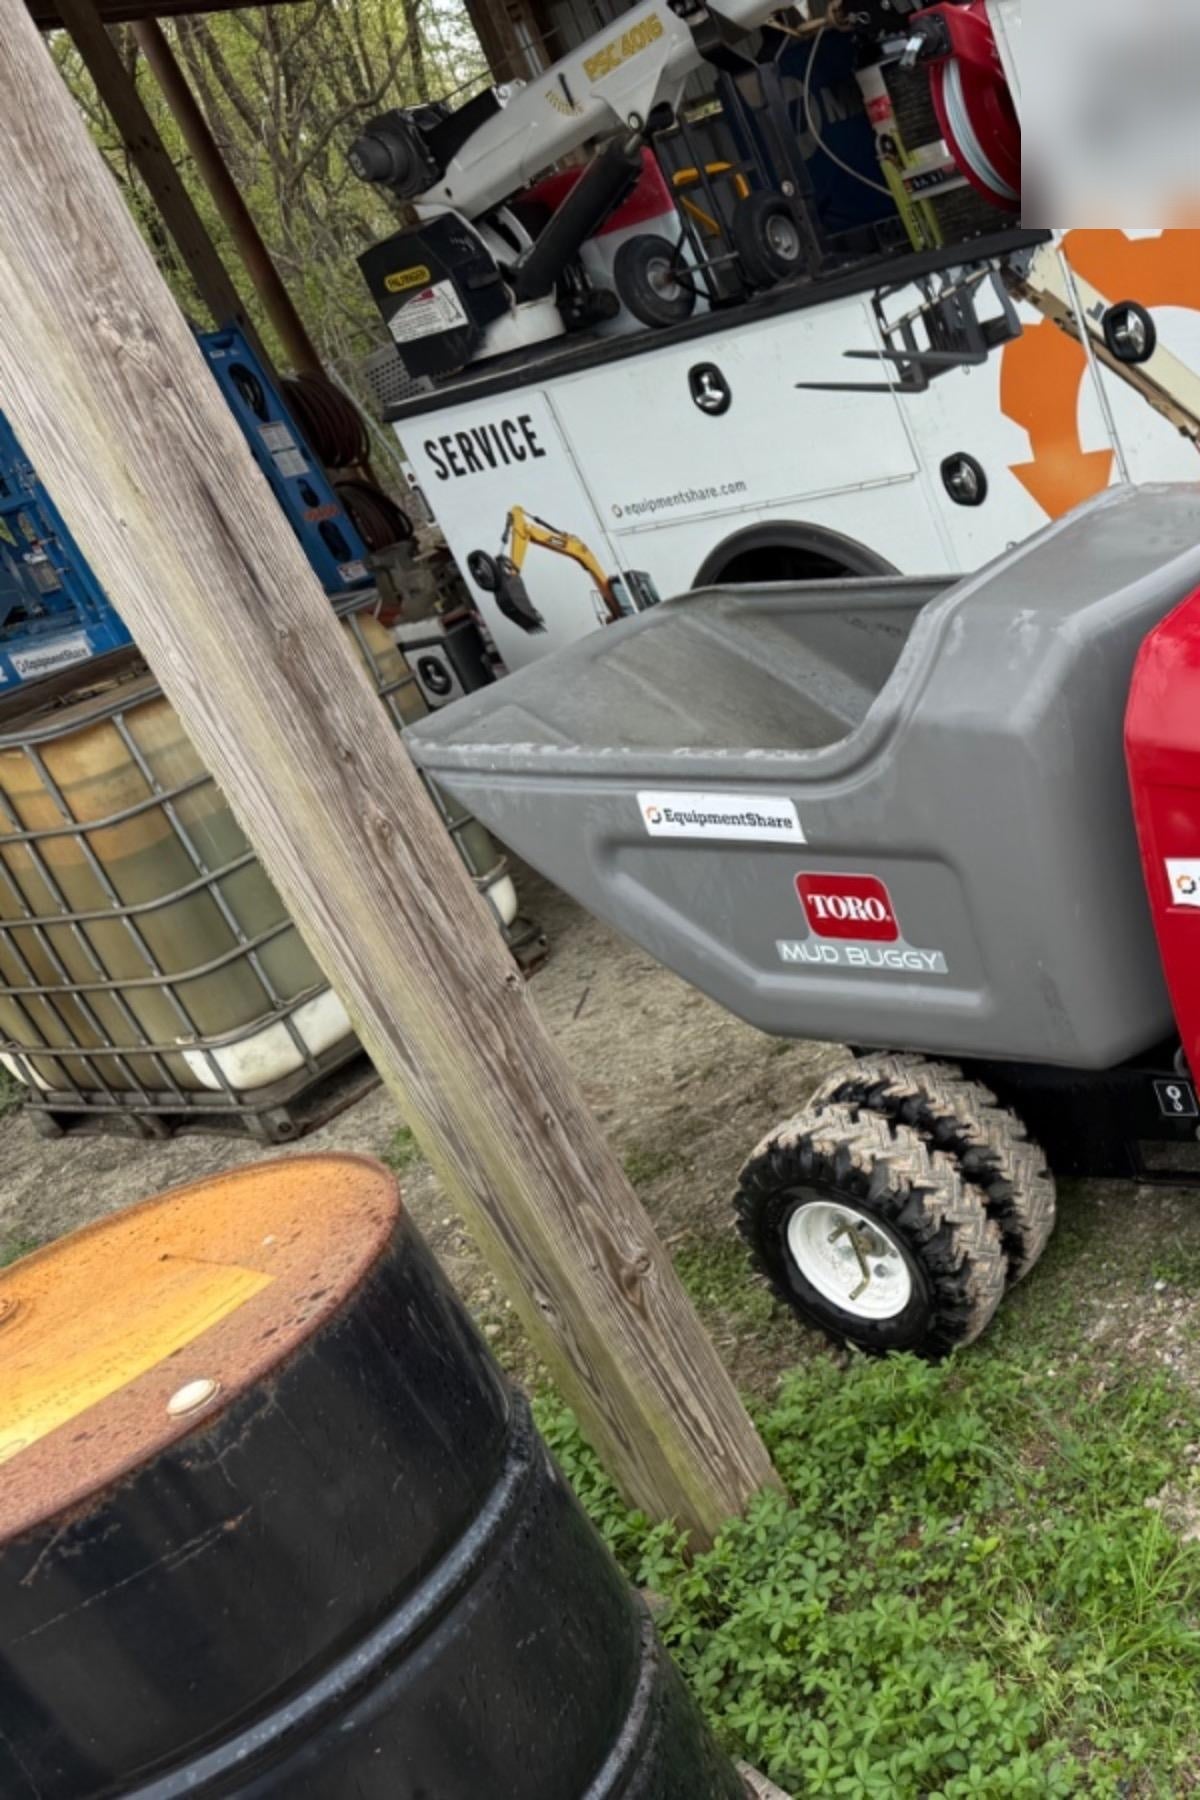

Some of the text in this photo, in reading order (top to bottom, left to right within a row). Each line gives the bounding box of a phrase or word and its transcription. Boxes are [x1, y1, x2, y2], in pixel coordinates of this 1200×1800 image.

[424, 414, 546, 481] SERVICE
[624, 479, 747, 516] equipmentshare.com
[663, 807, 793, 829] EquipmentShare
[781, 942, 940, 970] MUD BUGGY
